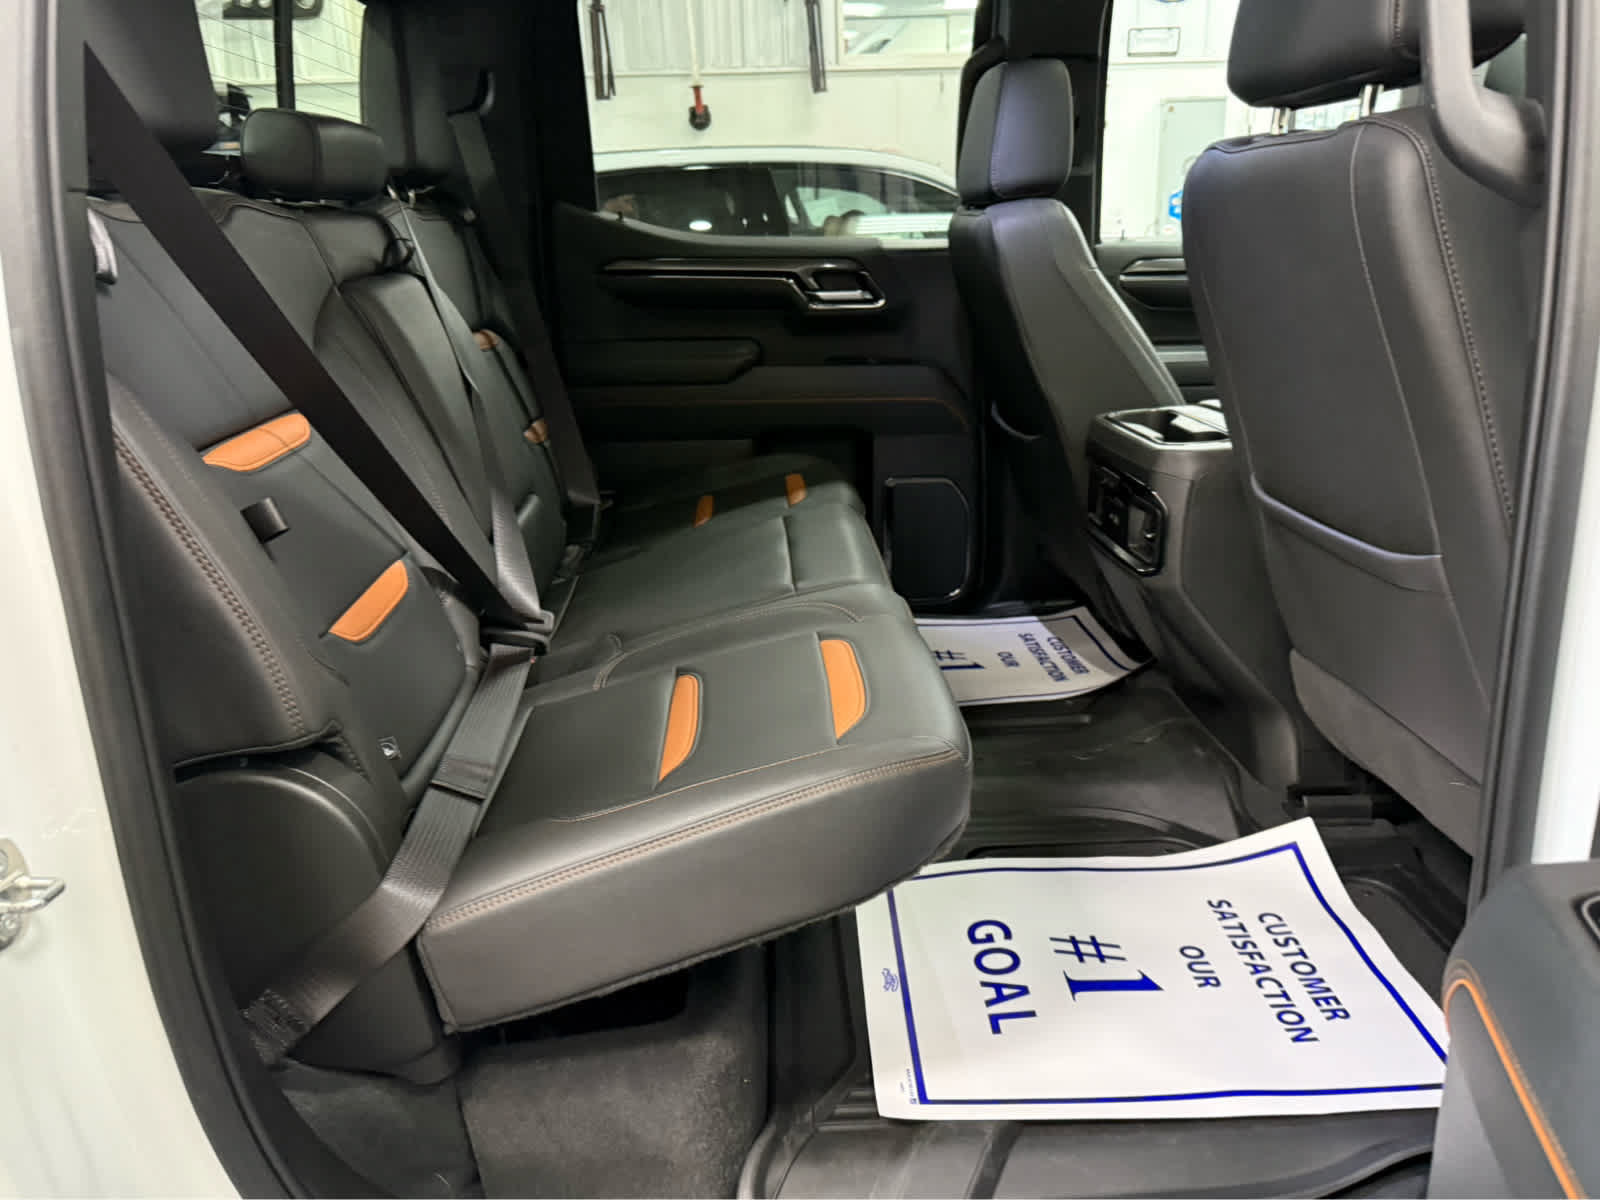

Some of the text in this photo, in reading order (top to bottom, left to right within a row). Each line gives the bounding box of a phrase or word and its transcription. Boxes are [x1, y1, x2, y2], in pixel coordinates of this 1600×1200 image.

[966, 919, 1037, 1035] GOAL
[1049, 935, 1164, 1001] #1
[1179, 945, 1222, 989] OUR
[1207, 898, 1320, 1043] SATISFACTION
[1258, 911, 1351, 1022] CUSTOMER
